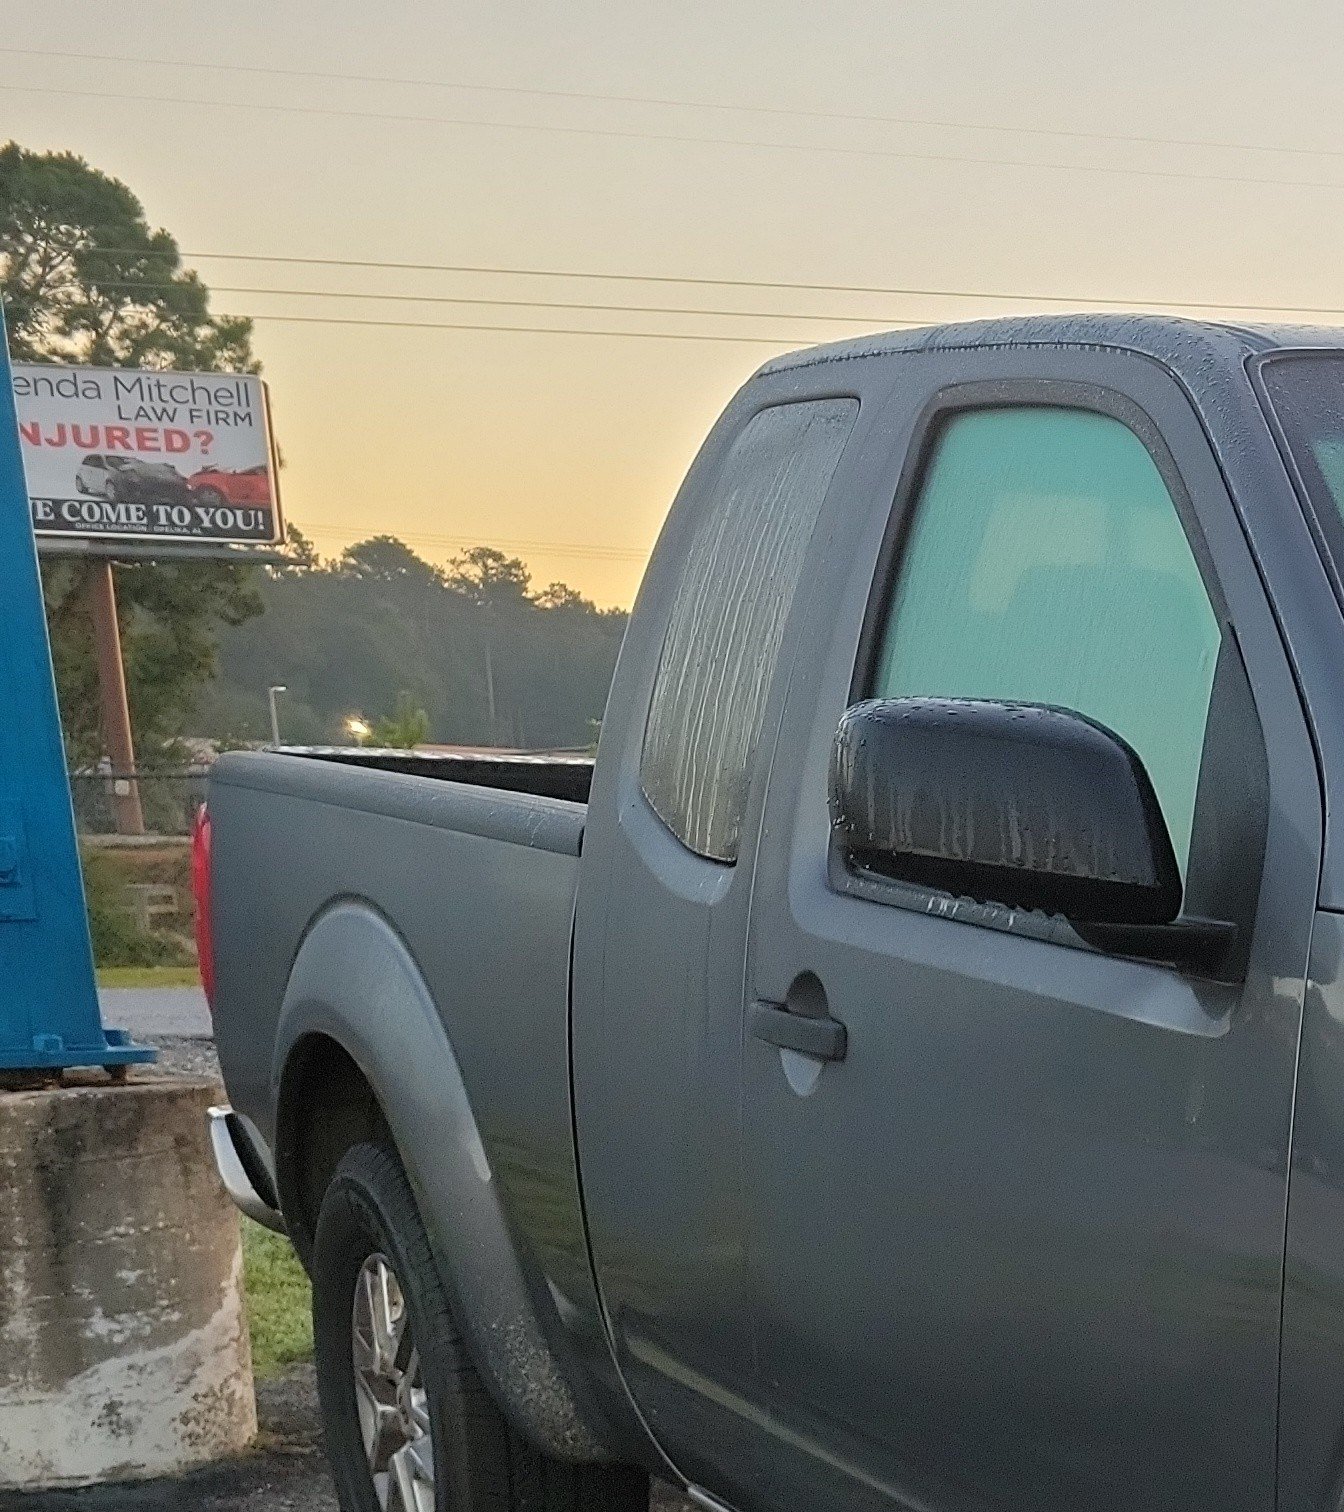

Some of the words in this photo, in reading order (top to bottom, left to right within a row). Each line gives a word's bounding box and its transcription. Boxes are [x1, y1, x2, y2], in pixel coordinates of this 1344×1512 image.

[13, 372, 102, 400] enda
[113, 375, 251, 408] Mitchell
[117, 404, 177, 423] LAW
[189, 407, 253, 427] FIRM
[20, 421, 214, 455] NJURED?
[34, 500, 55, 520] E
[61, 501, 148, 525] COME
[153, 505, 191, 527] TO
[195, 506, 265, 531] YOU!
